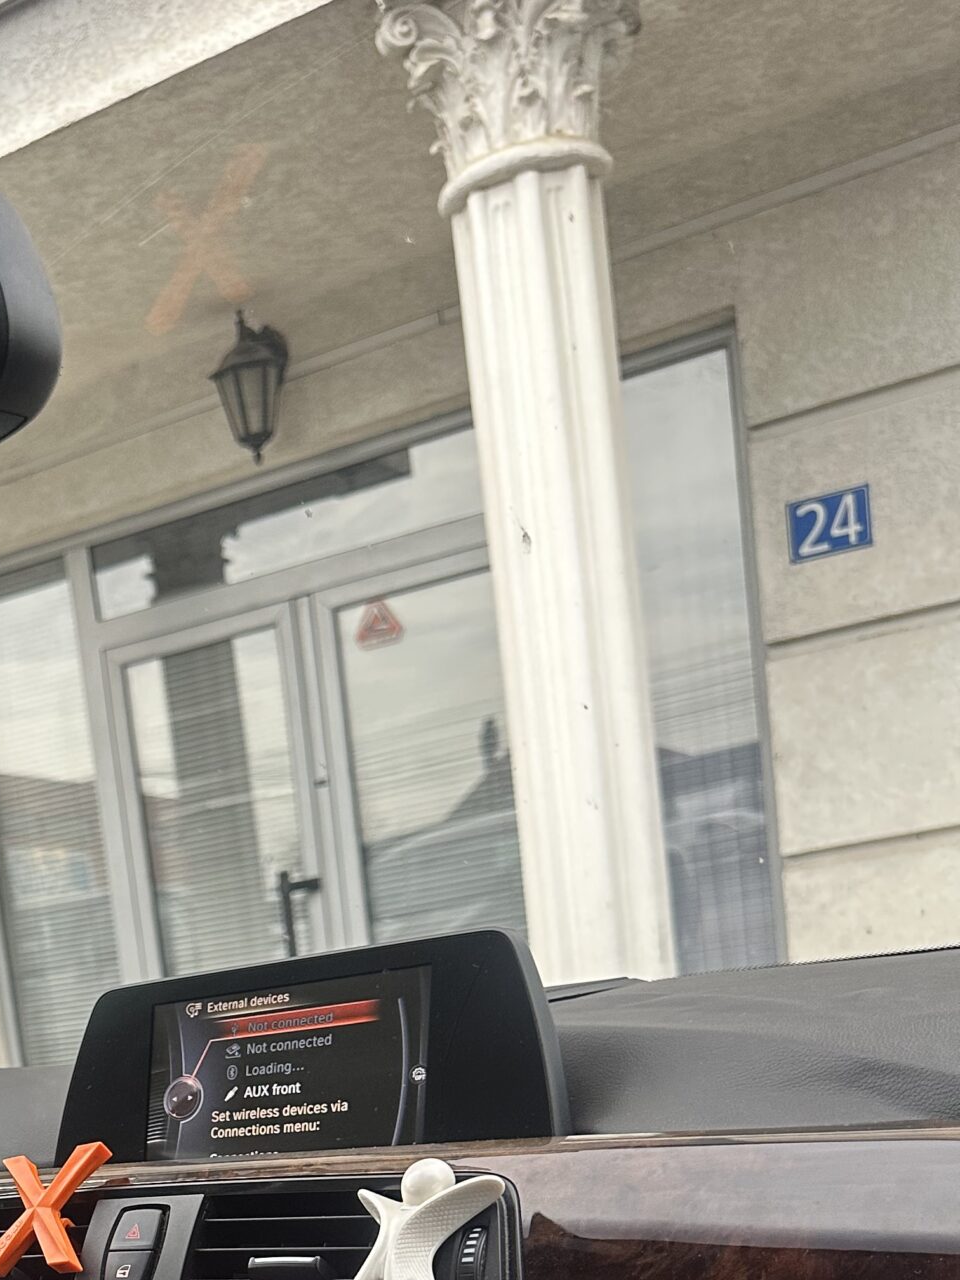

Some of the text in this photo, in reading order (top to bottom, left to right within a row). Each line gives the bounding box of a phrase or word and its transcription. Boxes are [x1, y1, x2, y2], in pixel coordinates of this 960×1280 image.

[796, 493, 863, 557] 24
[207, 992, 290, 1014] External devices
[248, 1012, 334, 1033] Not connected
[246, 1034, 332, 1055] Not connected
[245, 1061, 305, 1077] Loading...
[243, 1082, 301, 1099] AUX front
[211, 1099, 349, 1123] Set wireless devices via
[210, 1119, 320, 1139] Connections menu:
